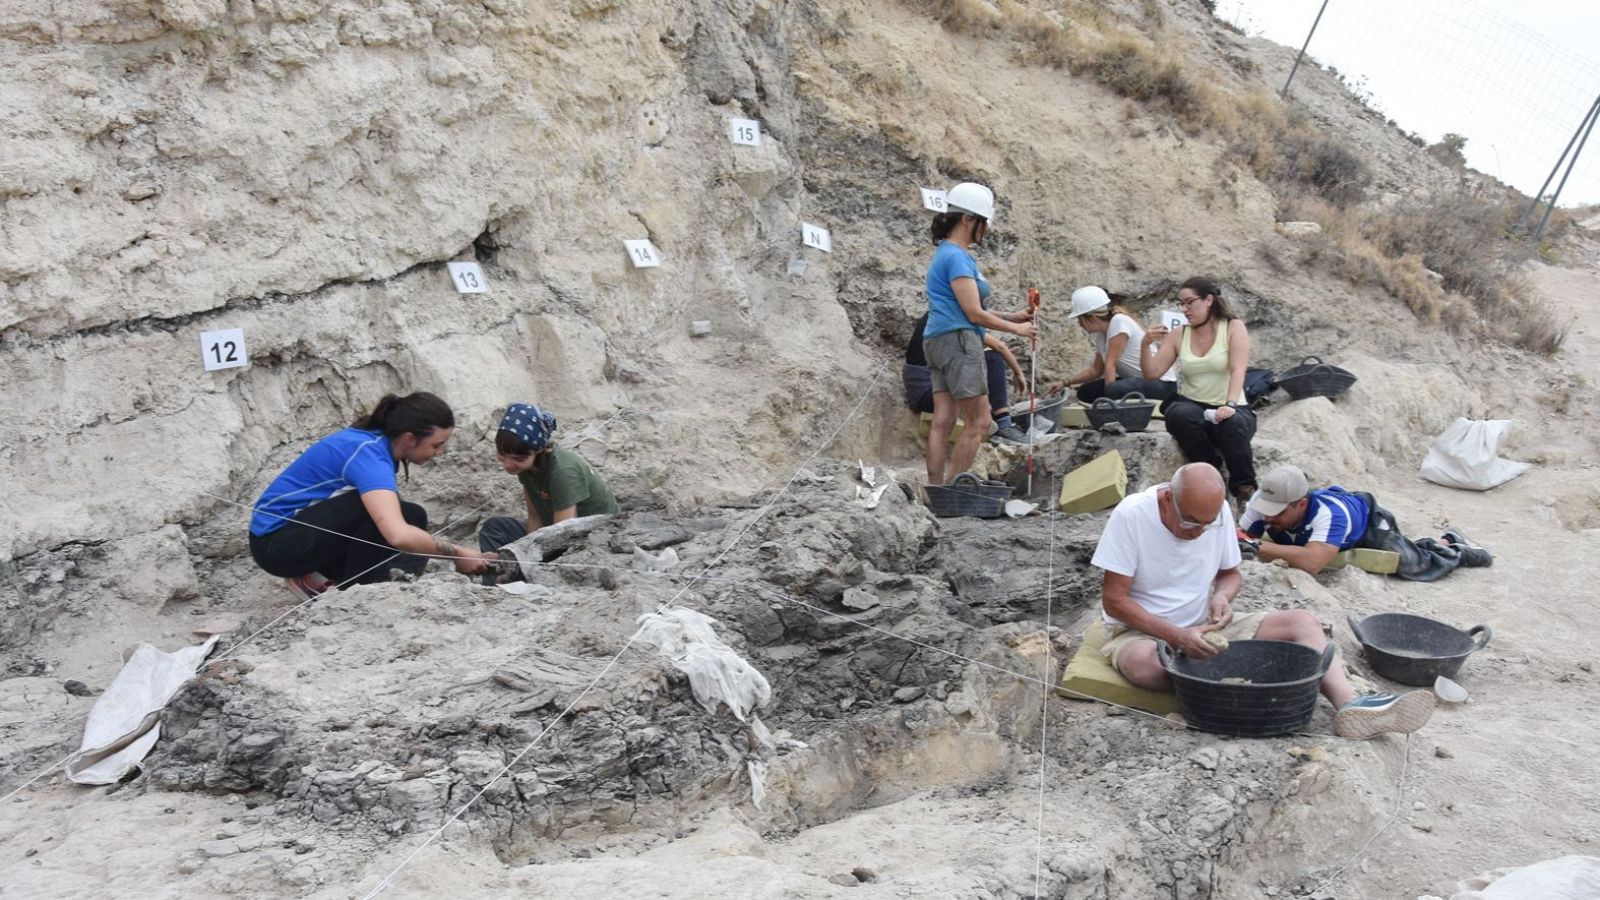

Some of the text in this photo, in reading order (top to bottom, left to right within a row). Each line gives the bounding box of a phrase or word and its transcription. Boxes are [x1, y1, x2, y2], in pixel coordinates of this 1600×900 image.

[738, 127, 754, 142] 15
[929, 196, 943, 210] 16
[811, 231, 820, 245] N
[634, 247, 652, 262] 14
[459, 271, 478, 289] 13
[210, 340, 238, 364] 12
